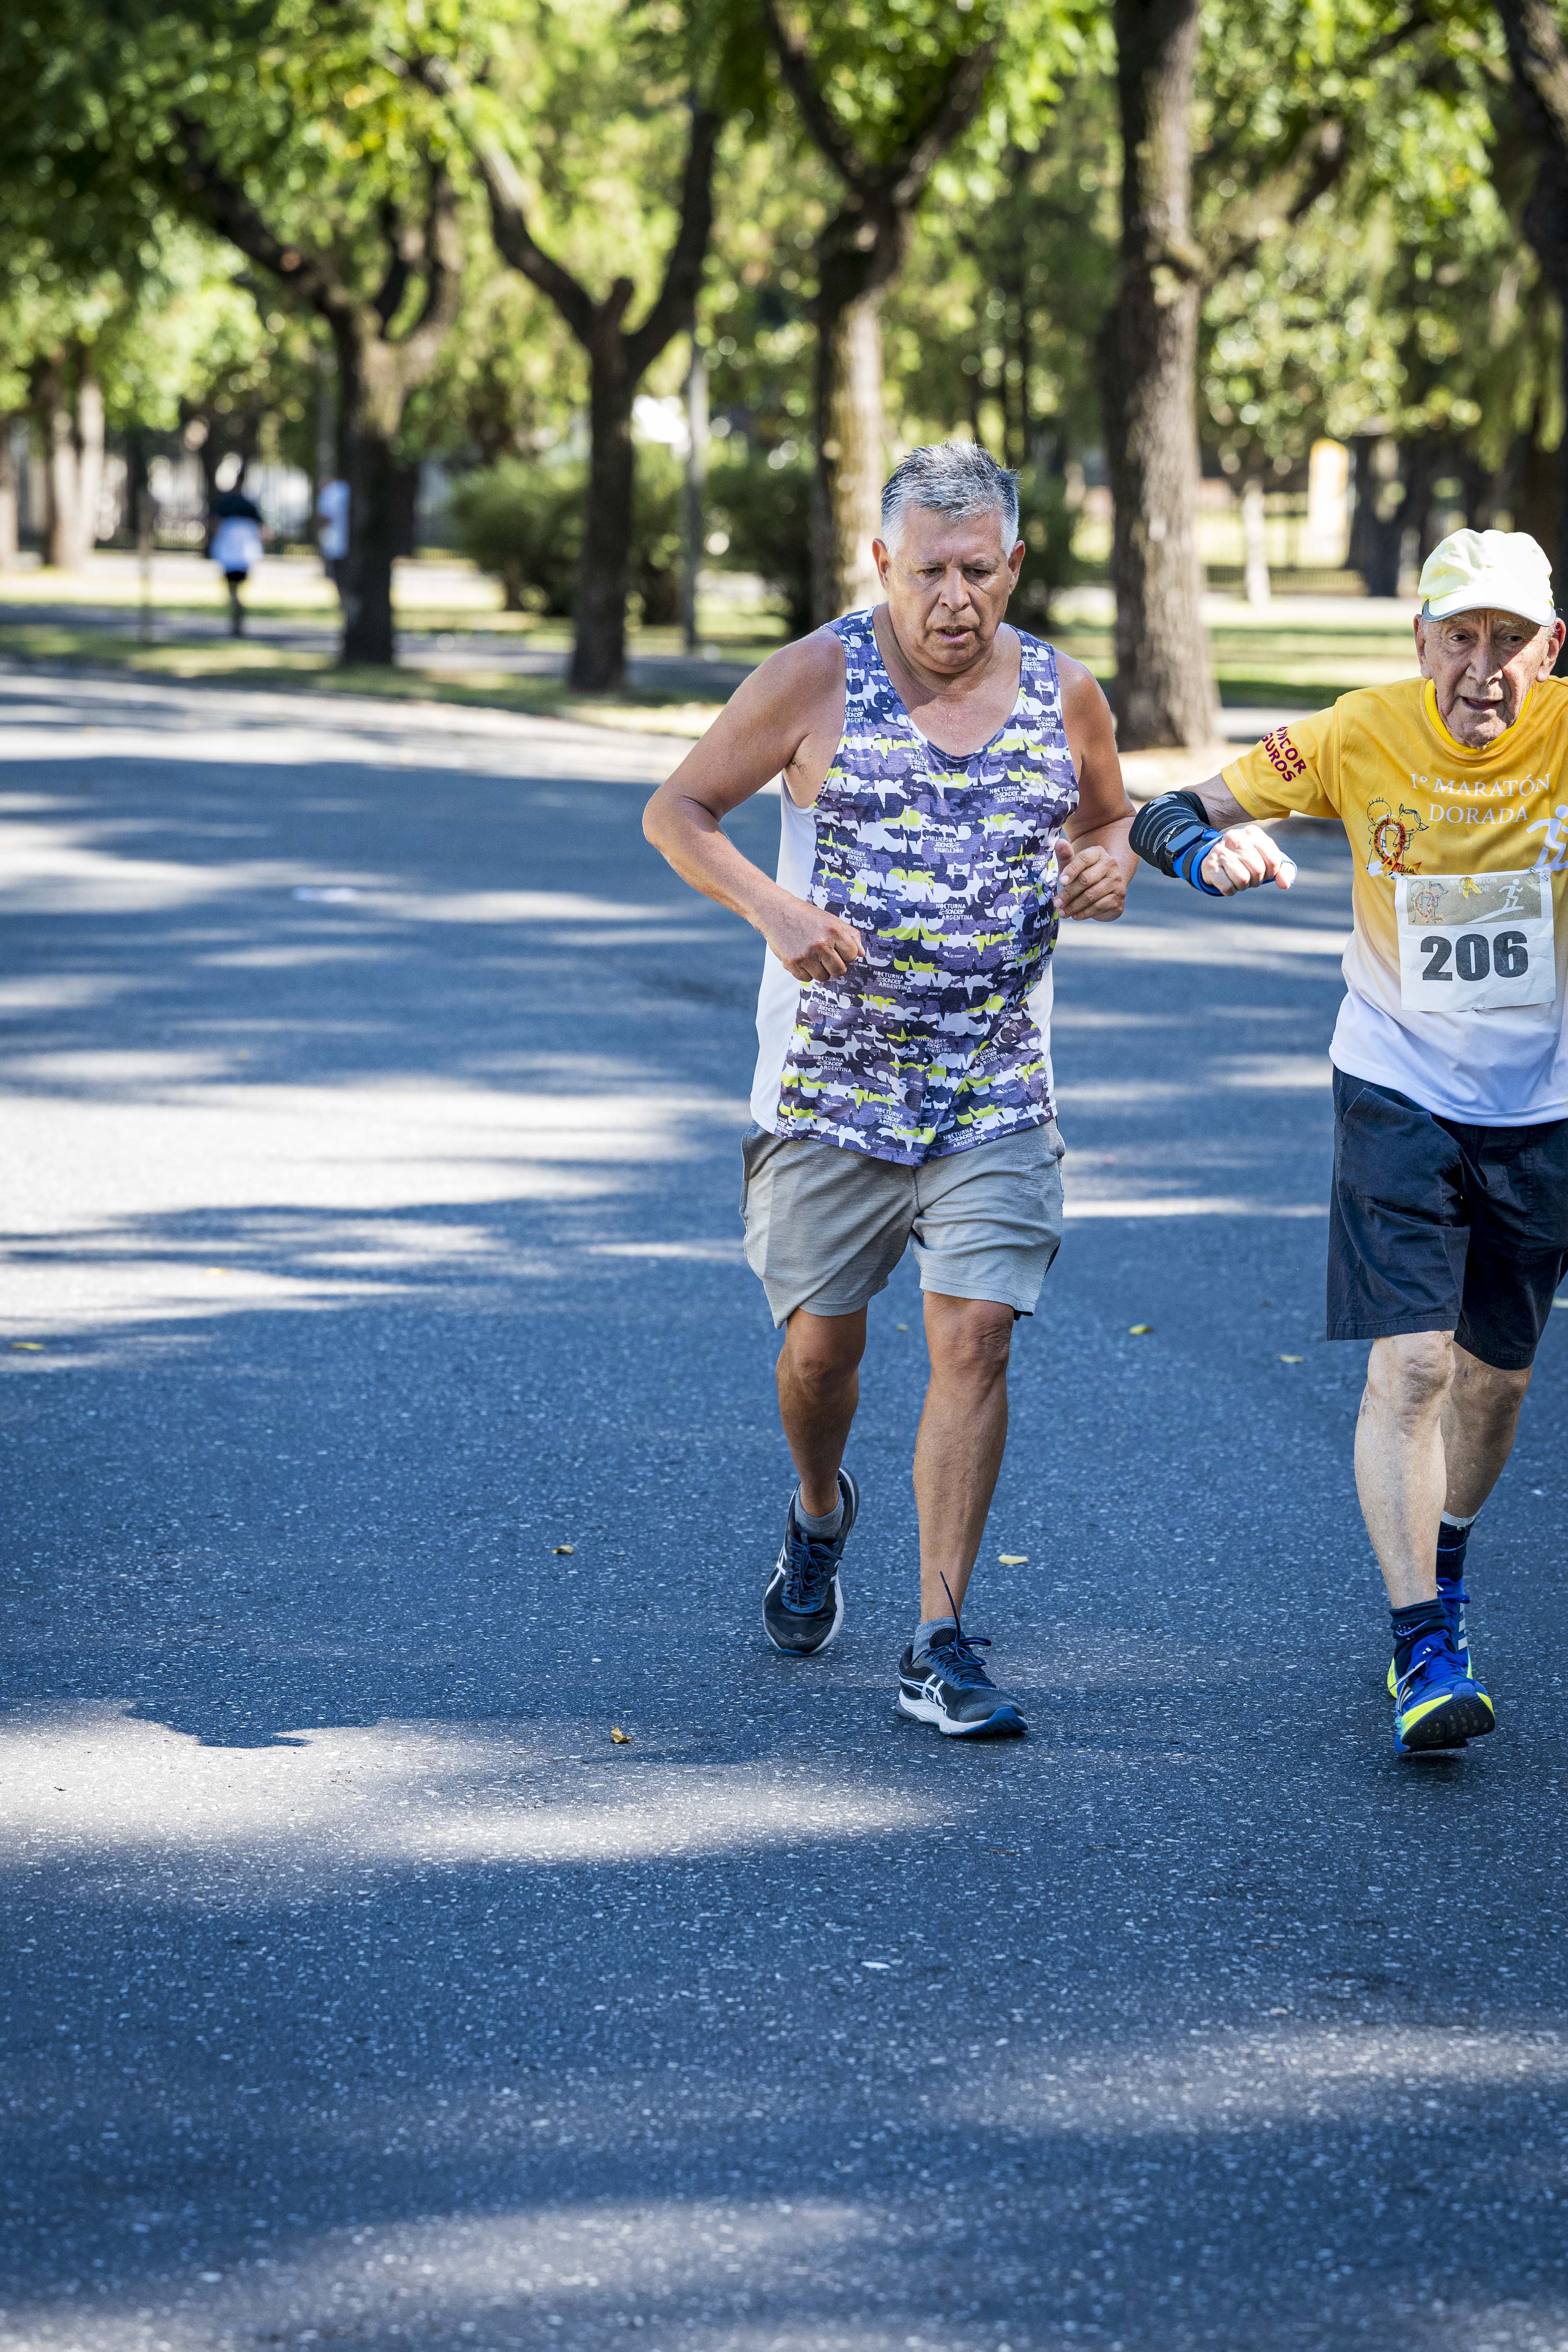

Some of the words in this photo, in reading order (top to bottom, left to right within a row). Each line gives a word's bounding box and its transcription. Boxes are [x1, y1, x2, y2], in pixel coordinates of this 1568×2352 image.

[990, 785, 1020, 794] NOCTURNA
[1433, 773, 1550, 796] MARATÓN
[1429, 803, 1528, 825] DORADA
[845, 858, 871, 869] NOCTURNA
[1420, 931, 1528, 981] 206
[873, 970, 904, 980] NOCTURNA
[878, 981, 912, 993] ARGENTINA
[980, 1053, 1010, 1066] ARGENTINA
[875, 1106, 903, 1119] NOCTURNA
[878, 1118, 907, 1131] ARGENTINA
[943, 1127, 974, 1141] NOCTURNA
[953, 1133, 987, 1148] ARGENTINA
